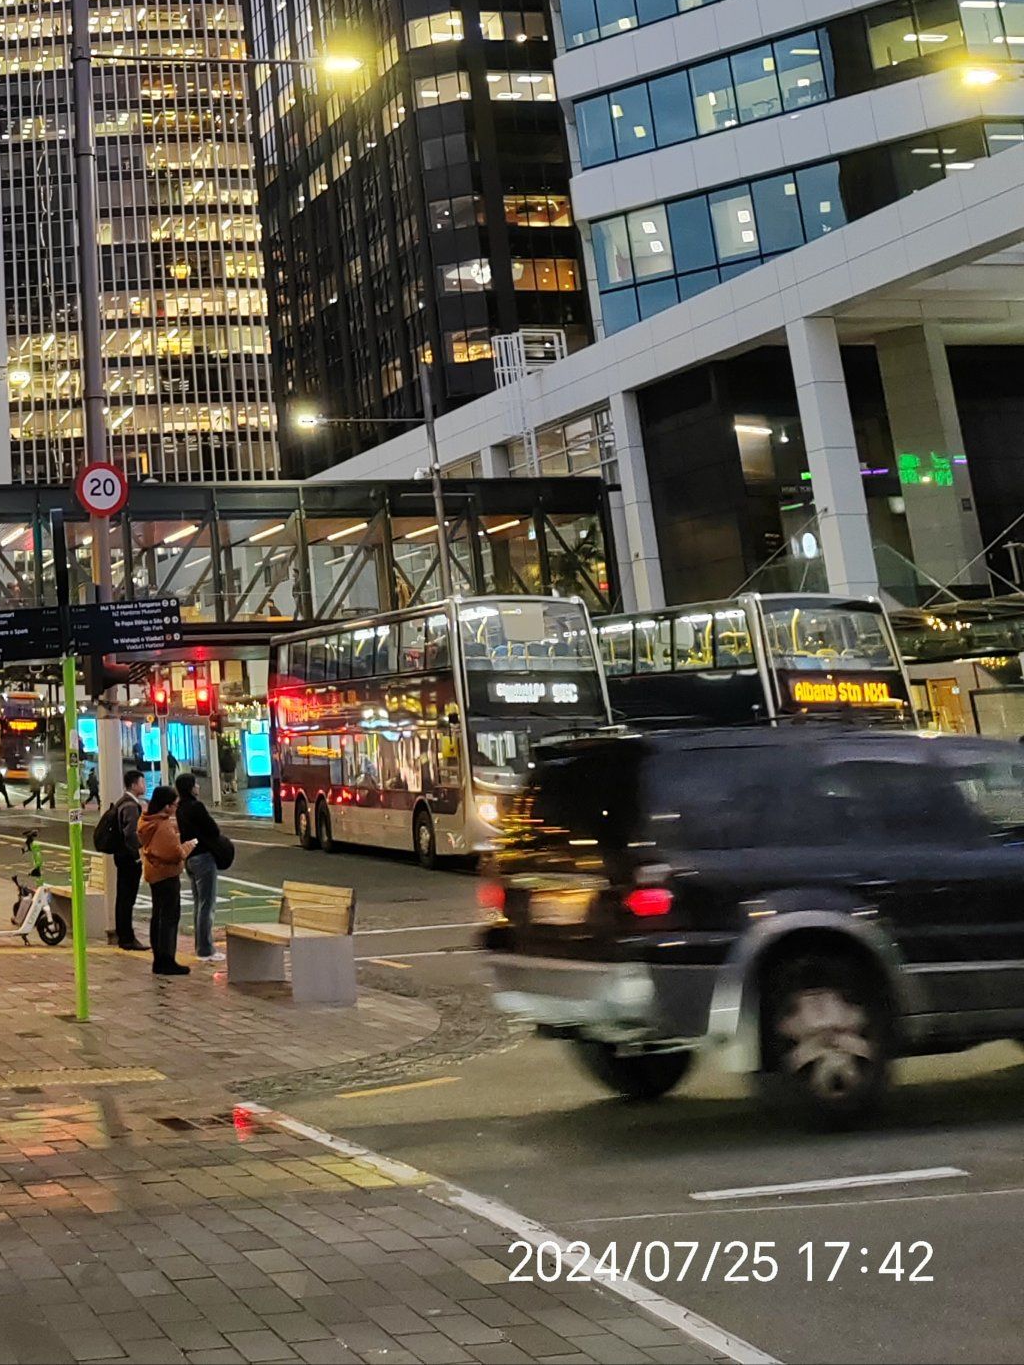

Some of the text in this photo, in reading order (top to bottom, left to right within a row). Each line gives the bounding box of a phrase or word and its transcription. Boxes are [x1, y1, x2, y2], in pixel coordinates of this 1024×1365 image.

[90, 478, 115, 496] 20
[14, 628, 29, 636] Spark
[795, 682, 889, 702] Albany Stn NX1
